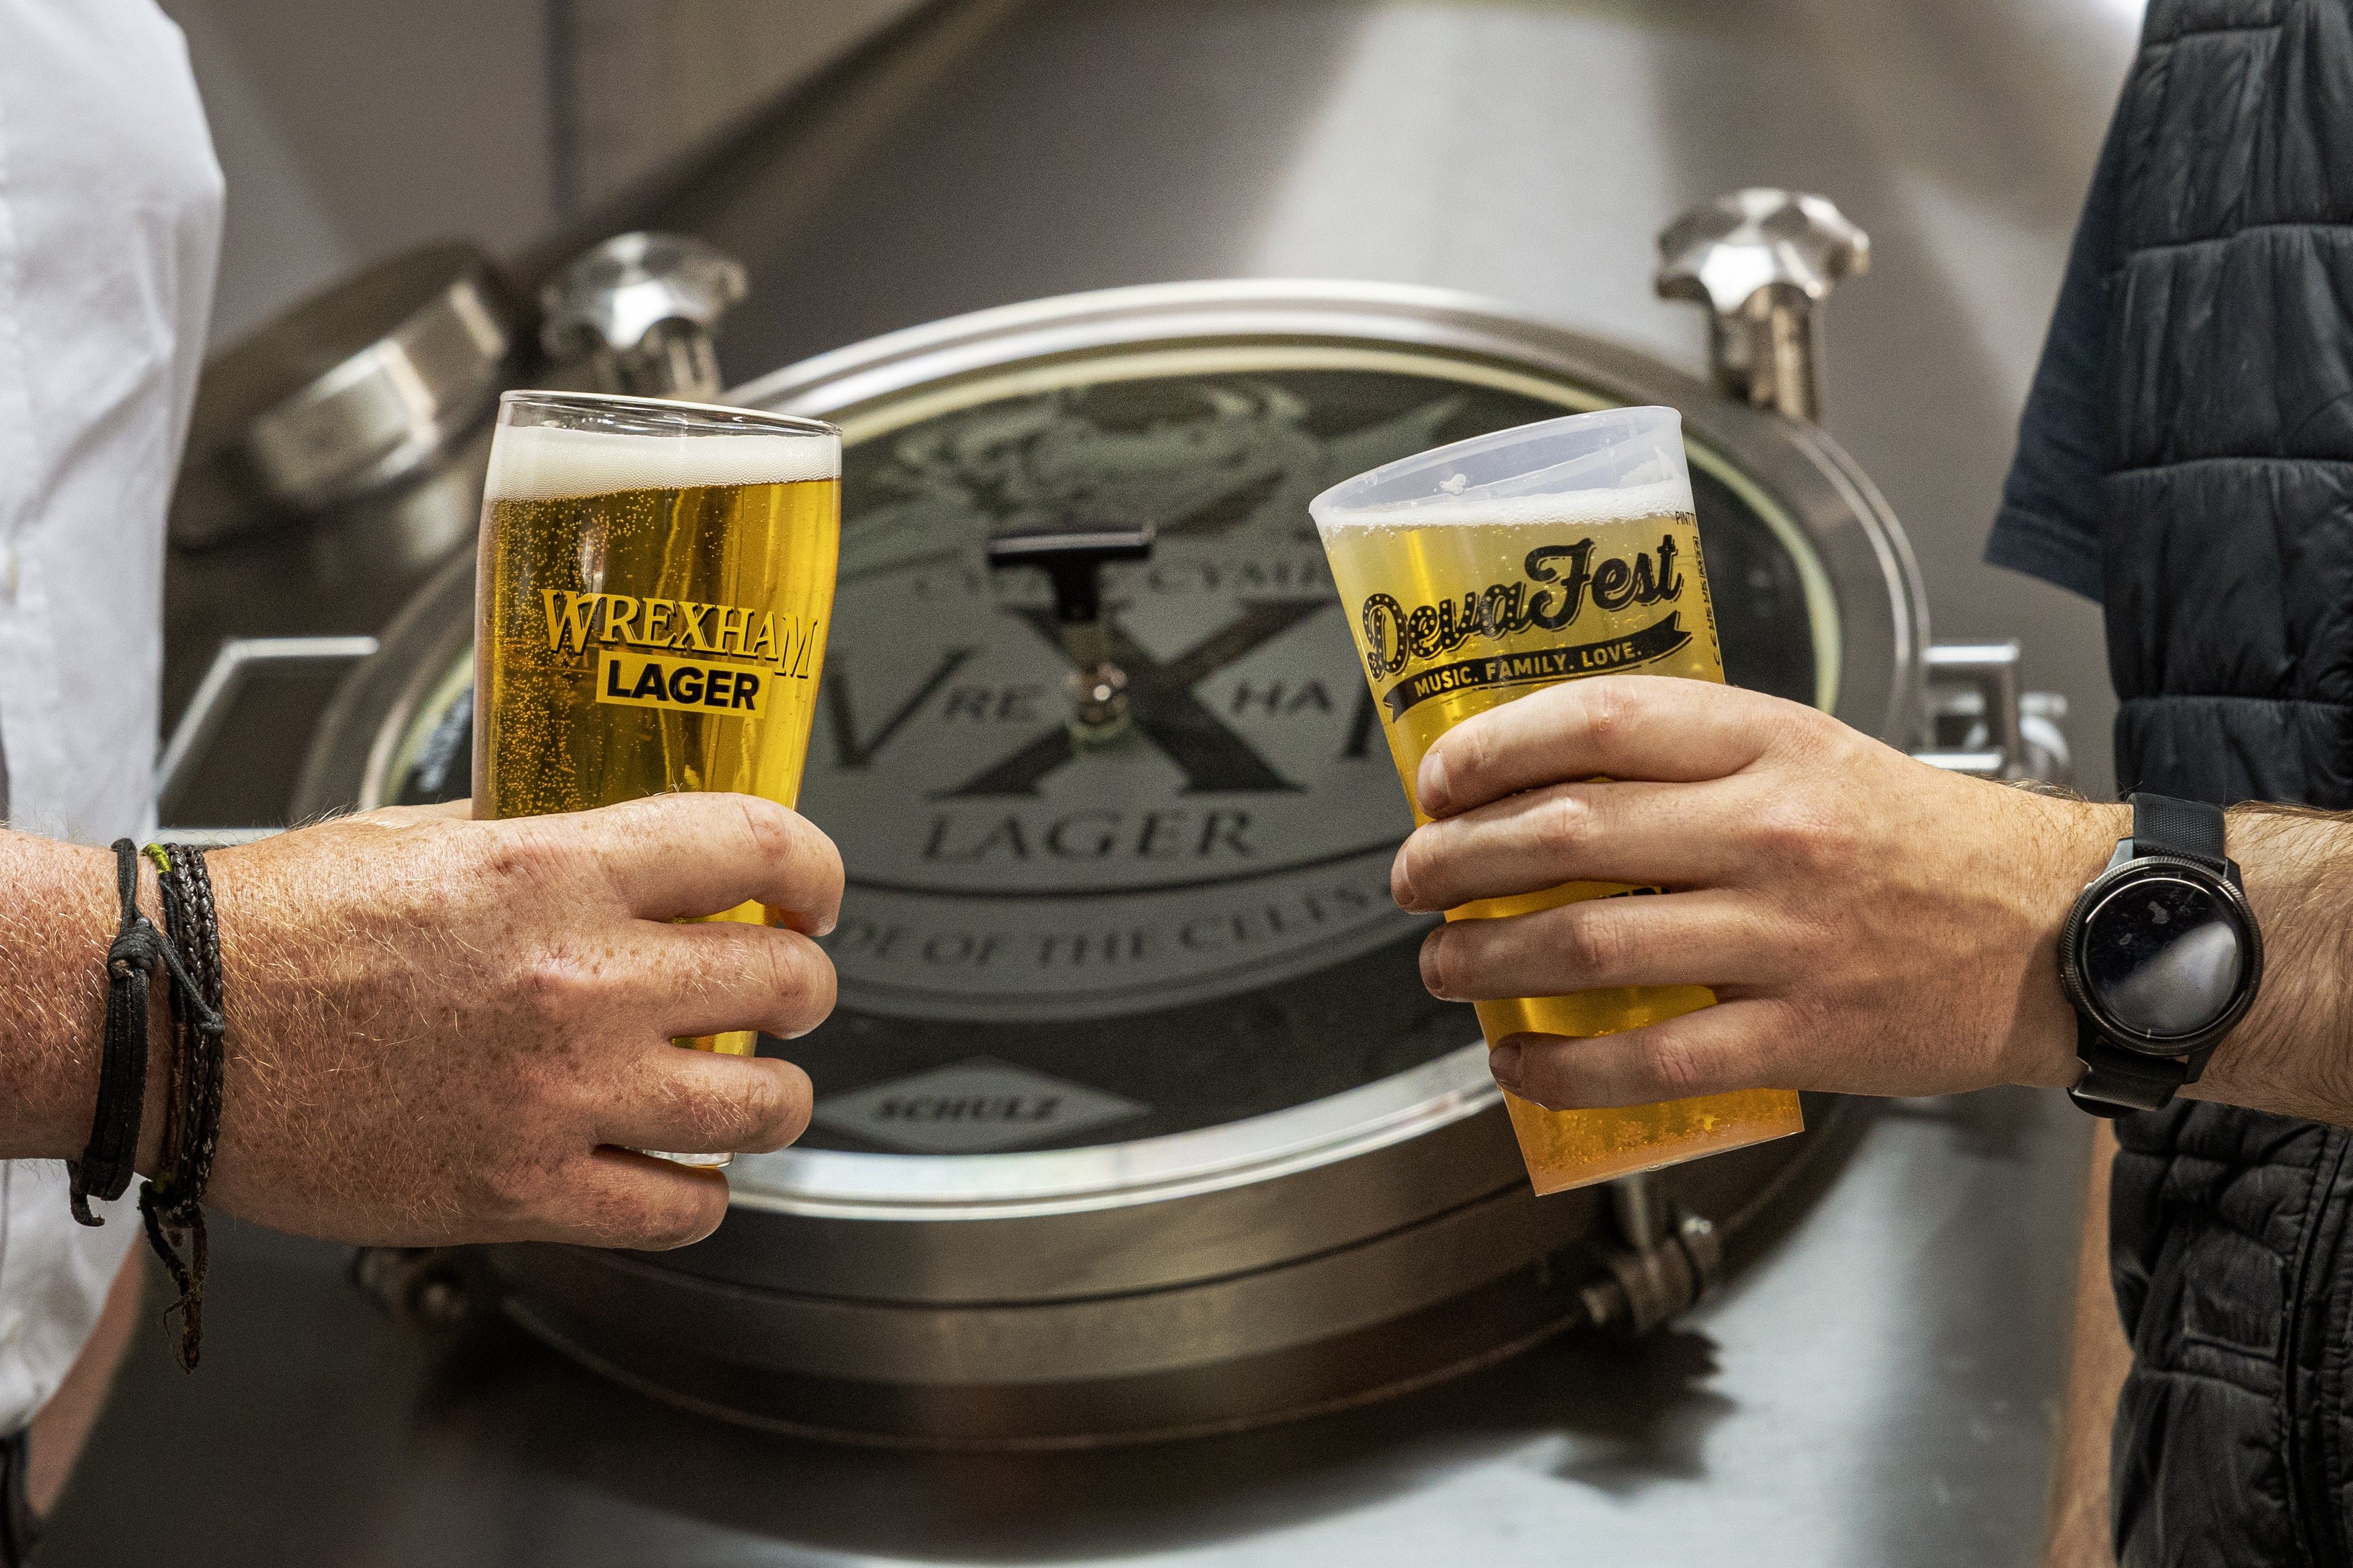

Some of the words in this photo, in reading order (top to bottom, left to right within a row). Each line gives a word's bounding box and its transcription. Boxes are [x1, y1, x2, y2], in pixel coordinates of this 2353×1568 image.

[1675, 511, 1691, 525] PINT
[540, 589, 818, 679] WREXHAM
[1363, 534, 1684, 679] DevaFest
[606, 659, 760, 711] LAGER
[1413, 667, 1478, 698] MUSIC.
[1485, 653, 1575, 681] FAMILY.
[1581, 641, 1643, 668] LOVE.
[919, 807, 1256, 863] LAGER
[872, 1092, 1065, 1124] SCHULZ
